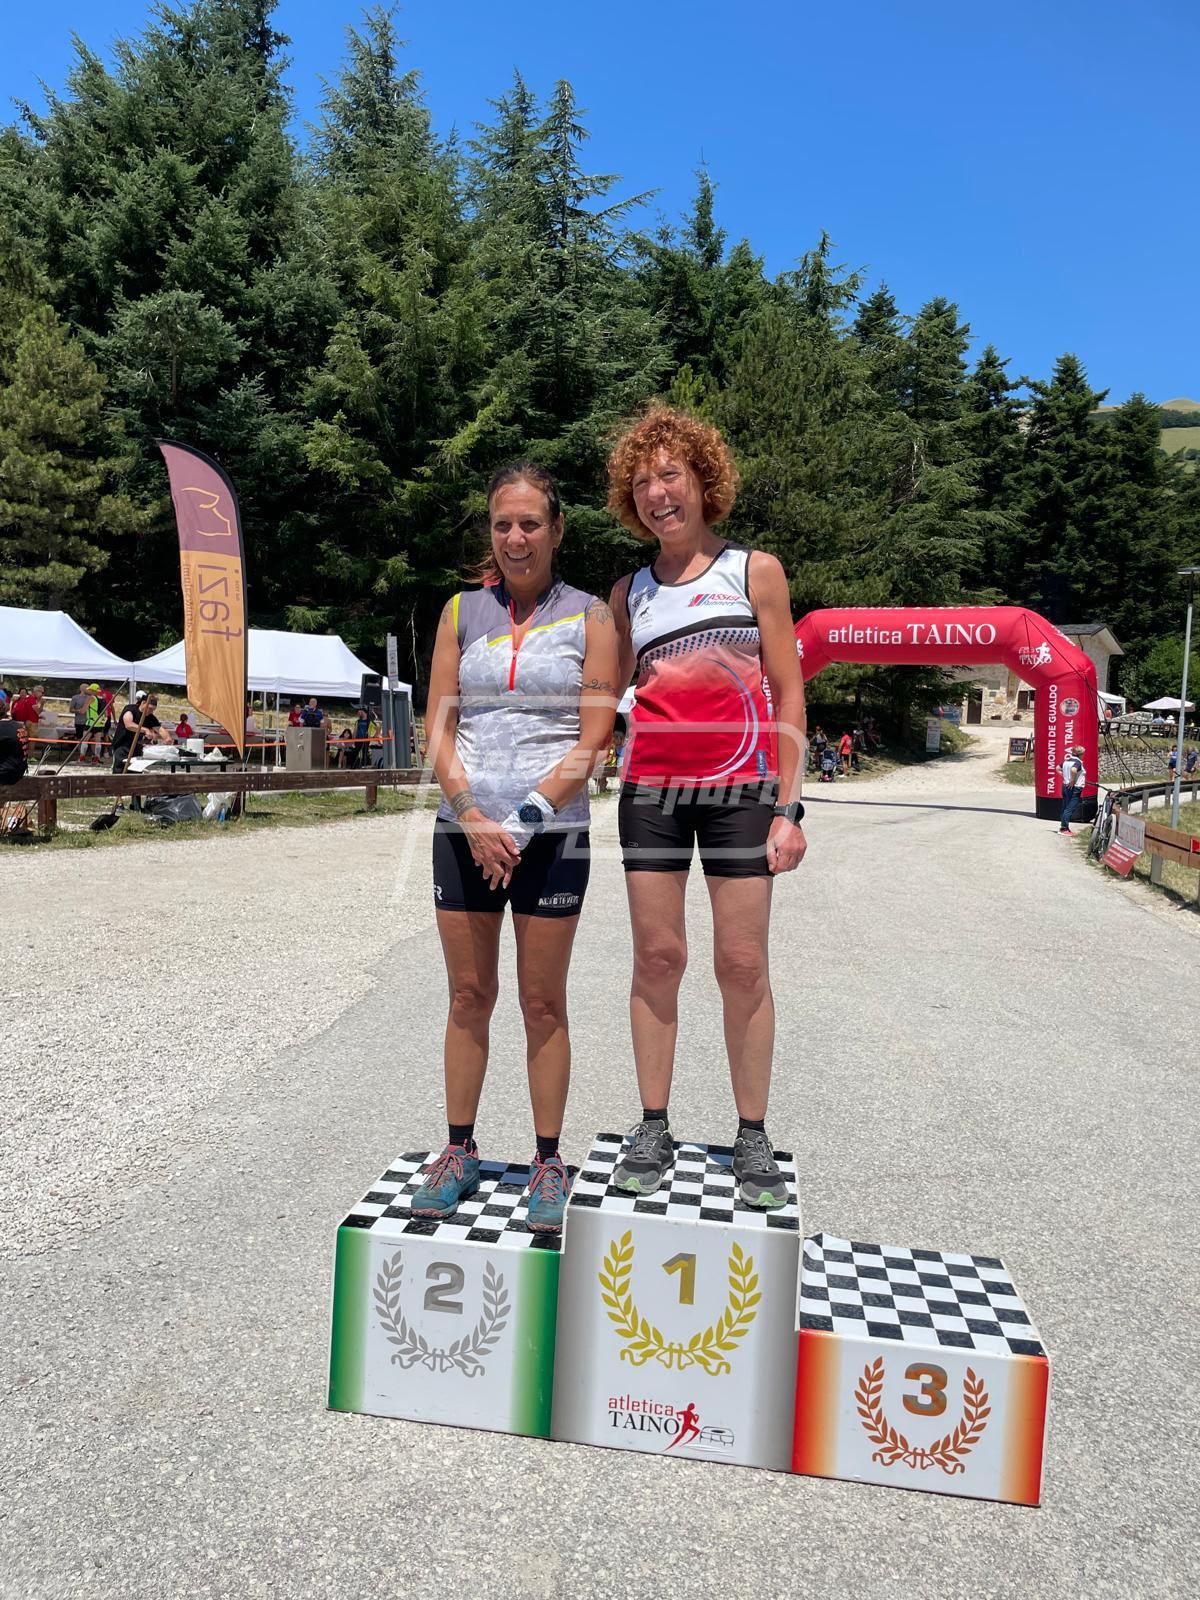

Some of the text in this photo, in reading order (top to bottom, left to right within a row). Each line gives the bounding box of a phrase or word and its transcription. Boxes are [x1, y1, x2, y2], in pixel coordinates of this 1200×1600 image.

[828, 623, 997, 645] atletica TAINO
[1048, 684, 1057, 723] GUALDO
[1048, 725, 1056, 738] DE
[1064, 719, 1074, 745] TRAIL
[1047, 740, 1056, 770] MONTI
[1047, 777, 1055, 794] TRA
[423, 1261, 465, 1316] 2
[661, 1252, 697, 1305] 1
[902, 1362, 948, 1417] 3
[608, 1393, 675, 1417] atletica
[608, 1410, 680, 1436] TAINO
